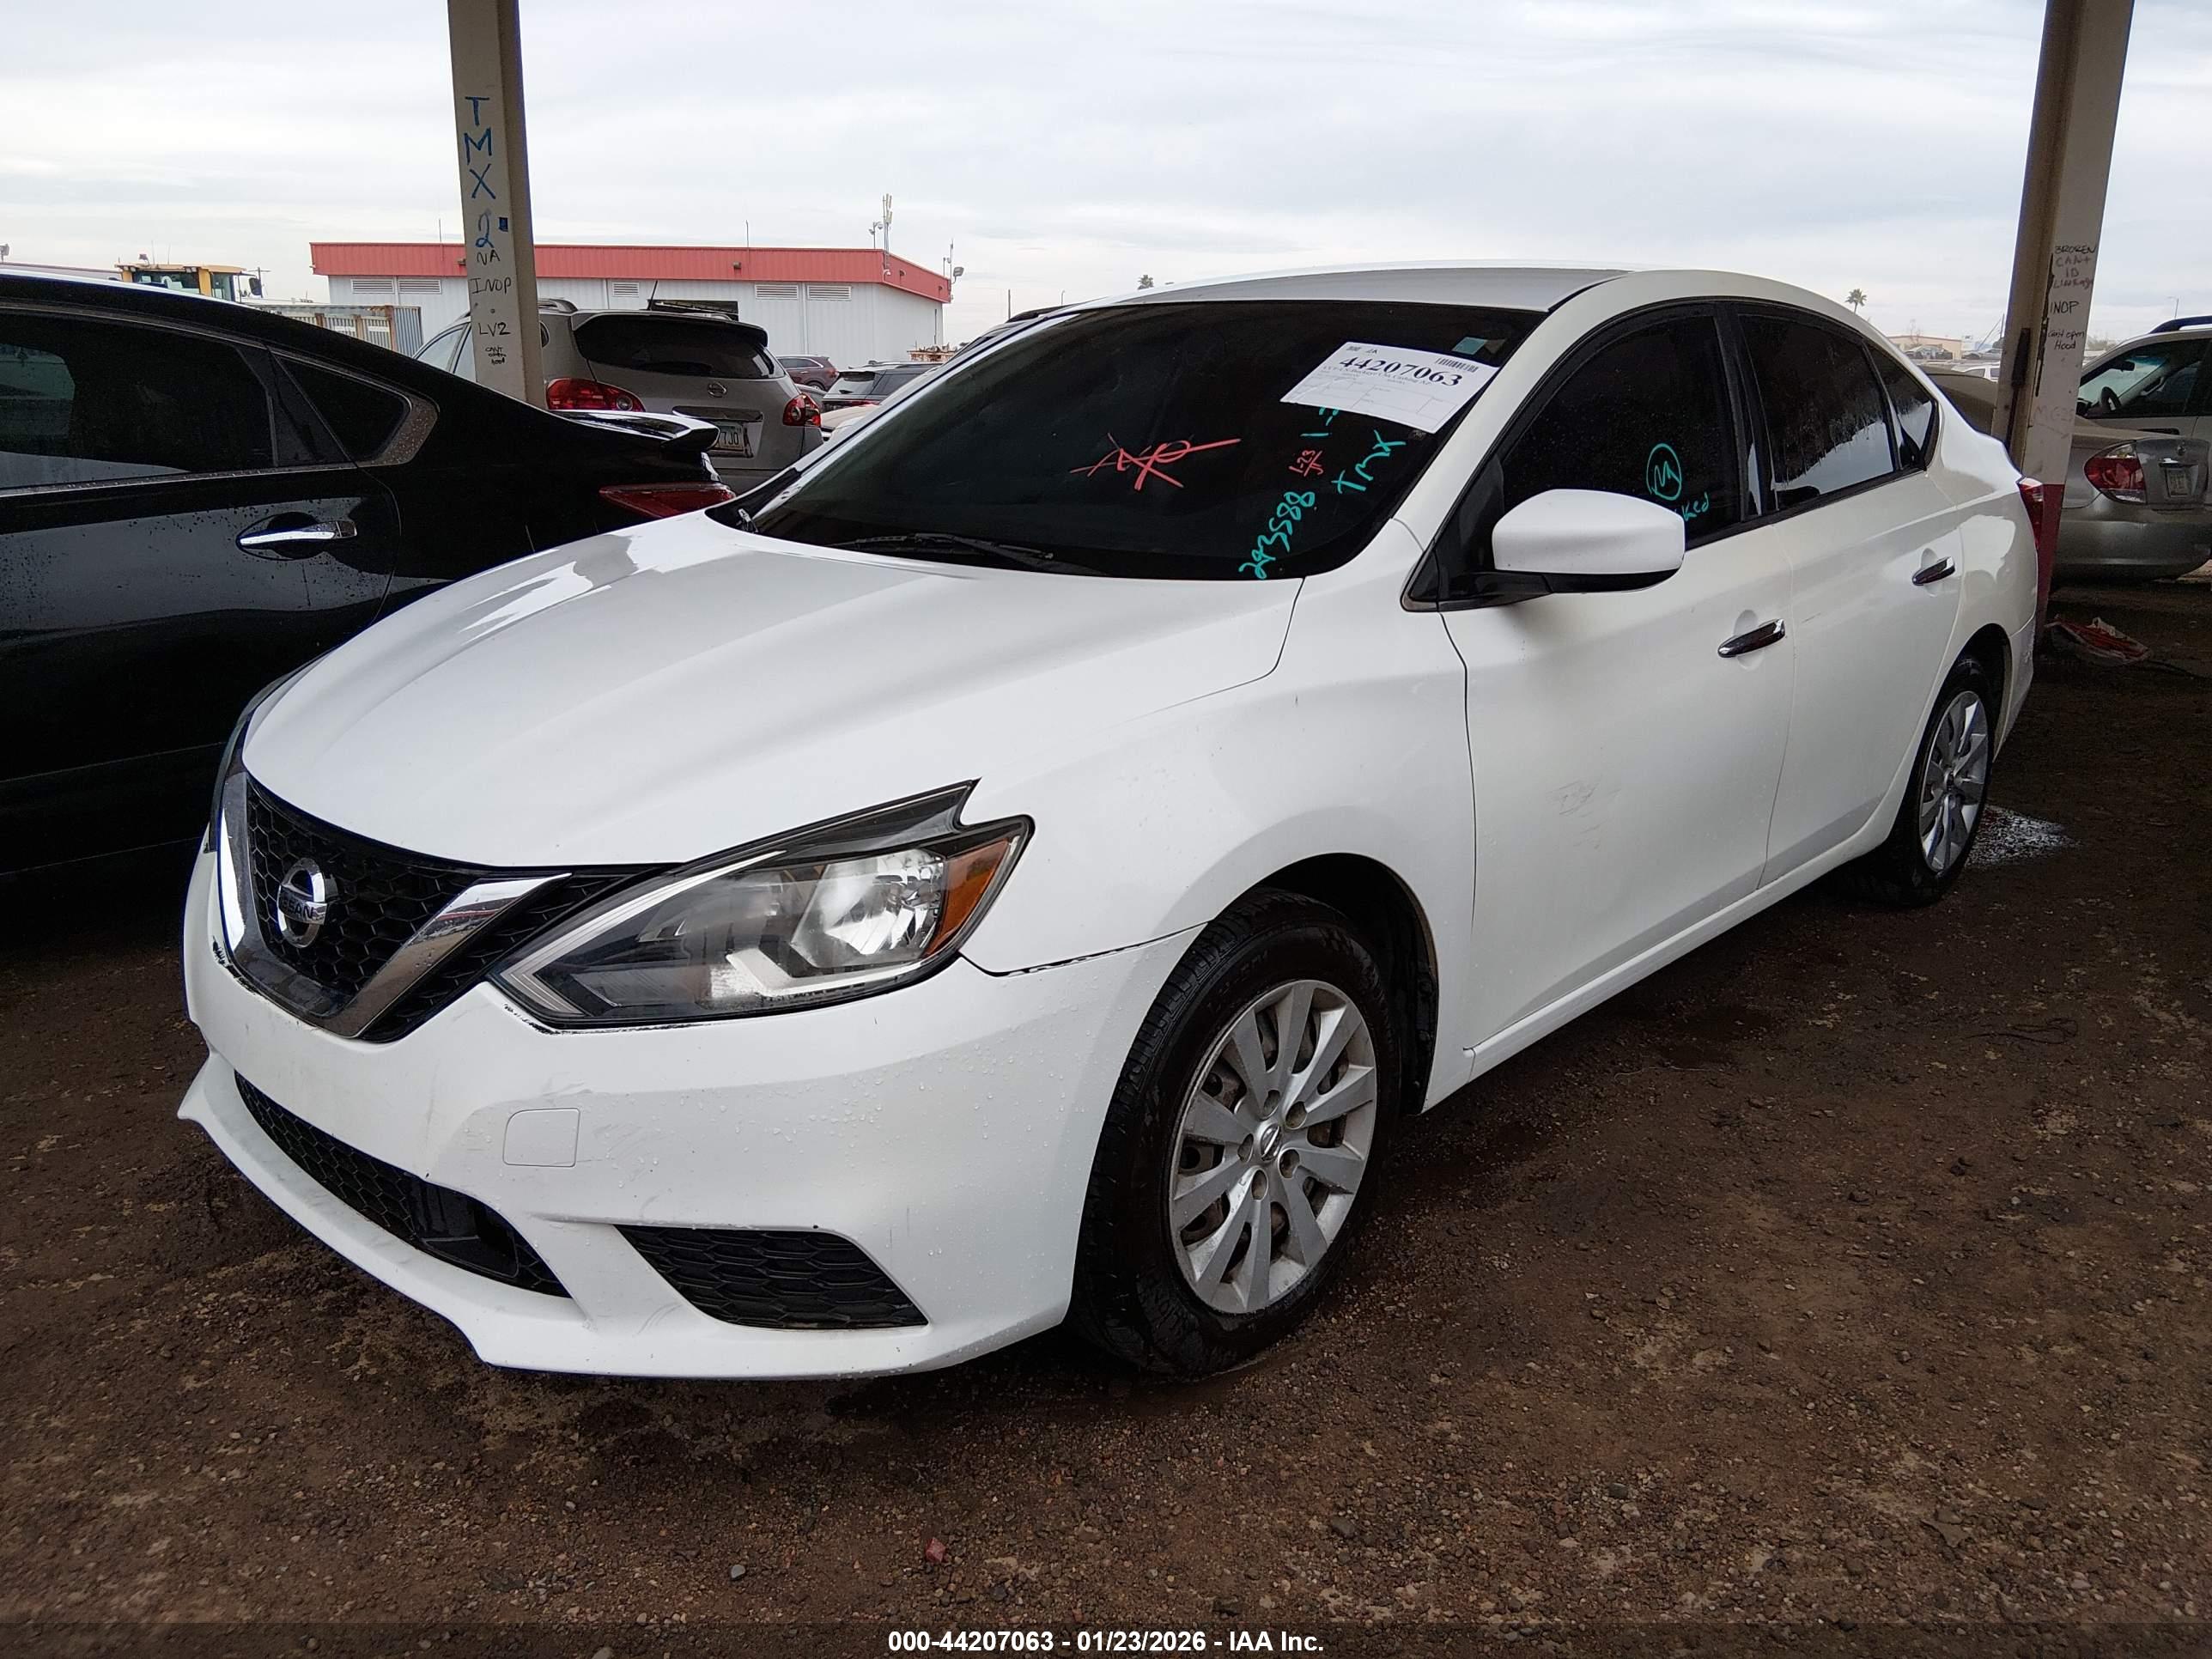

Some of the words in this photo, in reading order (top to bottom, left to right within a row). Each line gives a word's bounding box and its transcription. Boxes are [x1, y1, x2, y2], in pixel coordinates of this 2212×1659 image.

[464, 95, 496, 199] TMX
[477, 249, 501, 265] NA
[471, 276, 512, 295] INOP
[2050, 301, 2079, 315] INOP
[477, 321, 511, 337] LV2
[1339, 356, 1463, 387] 44207063
